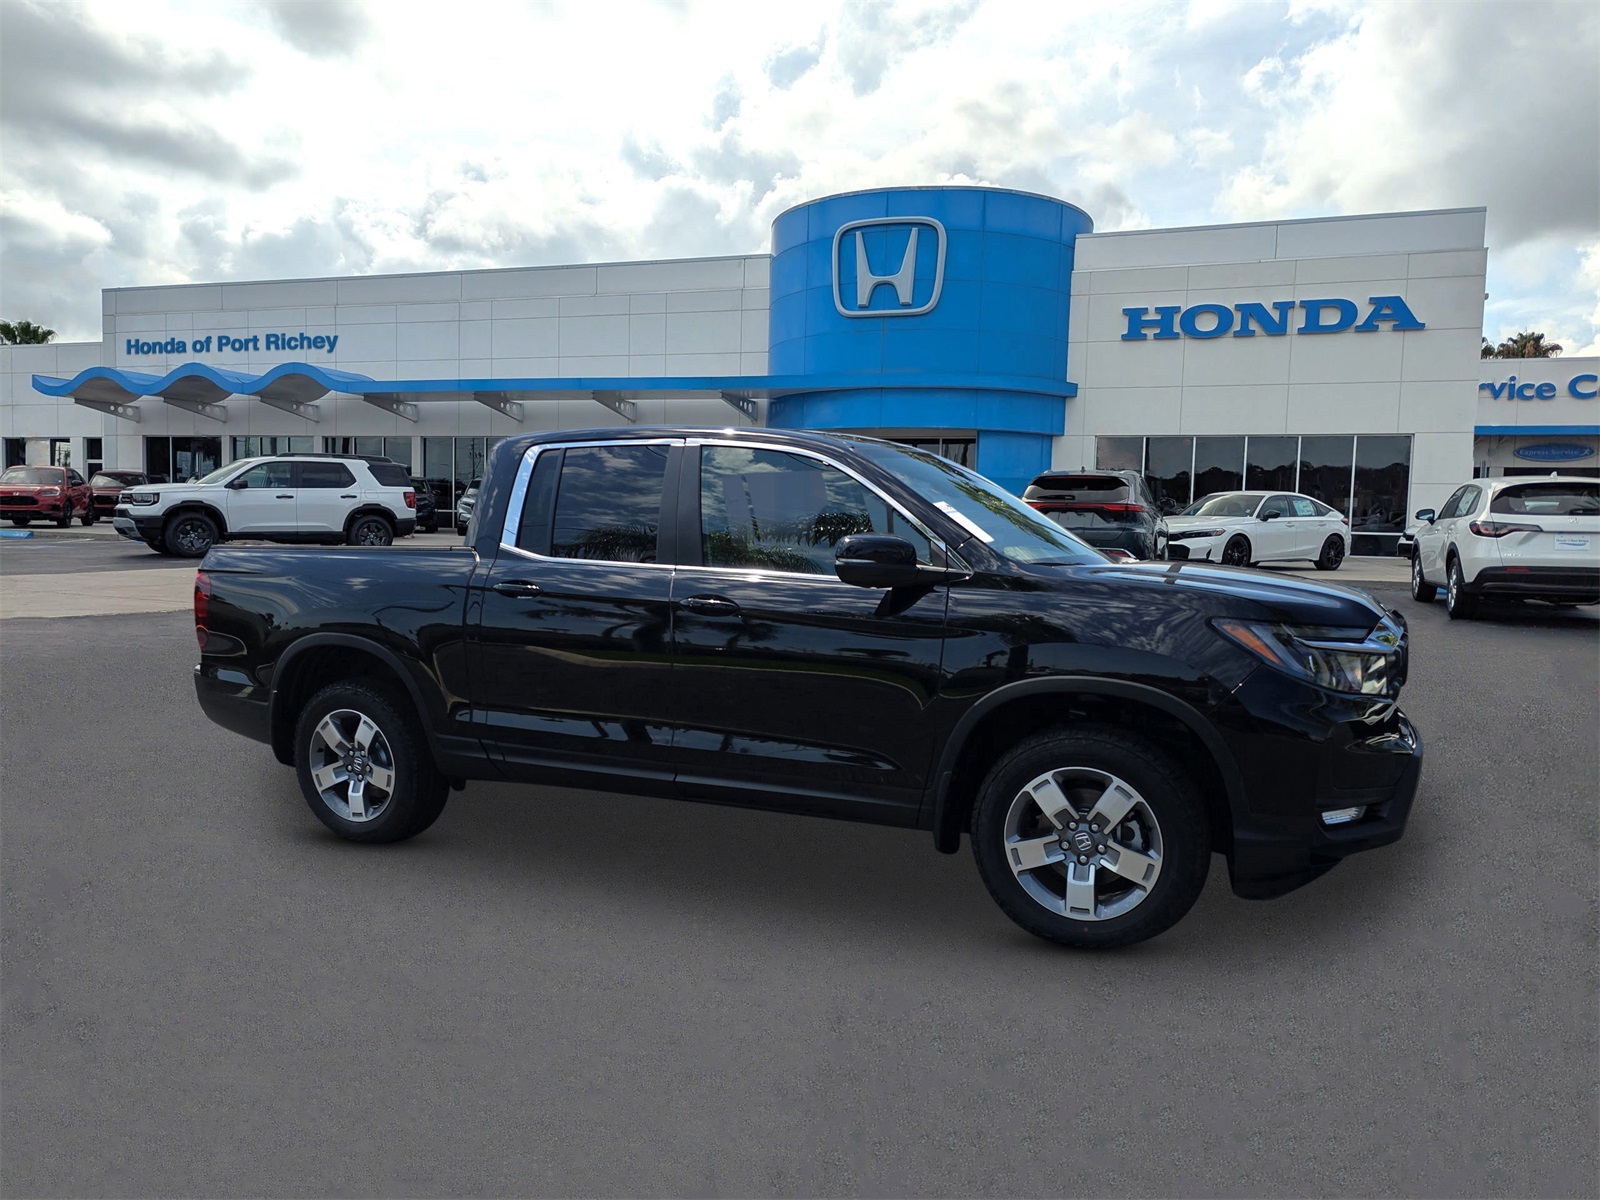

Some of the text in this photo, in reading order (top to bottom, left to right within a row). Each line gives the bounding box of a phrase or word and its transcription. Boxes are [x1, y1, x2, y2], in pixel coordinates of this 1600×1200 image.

[1120, 295, 1426, 341] HONDA
[126, 332, 339, 355] Honda of Port Richey
[1567, 373, 1600, 400] C
